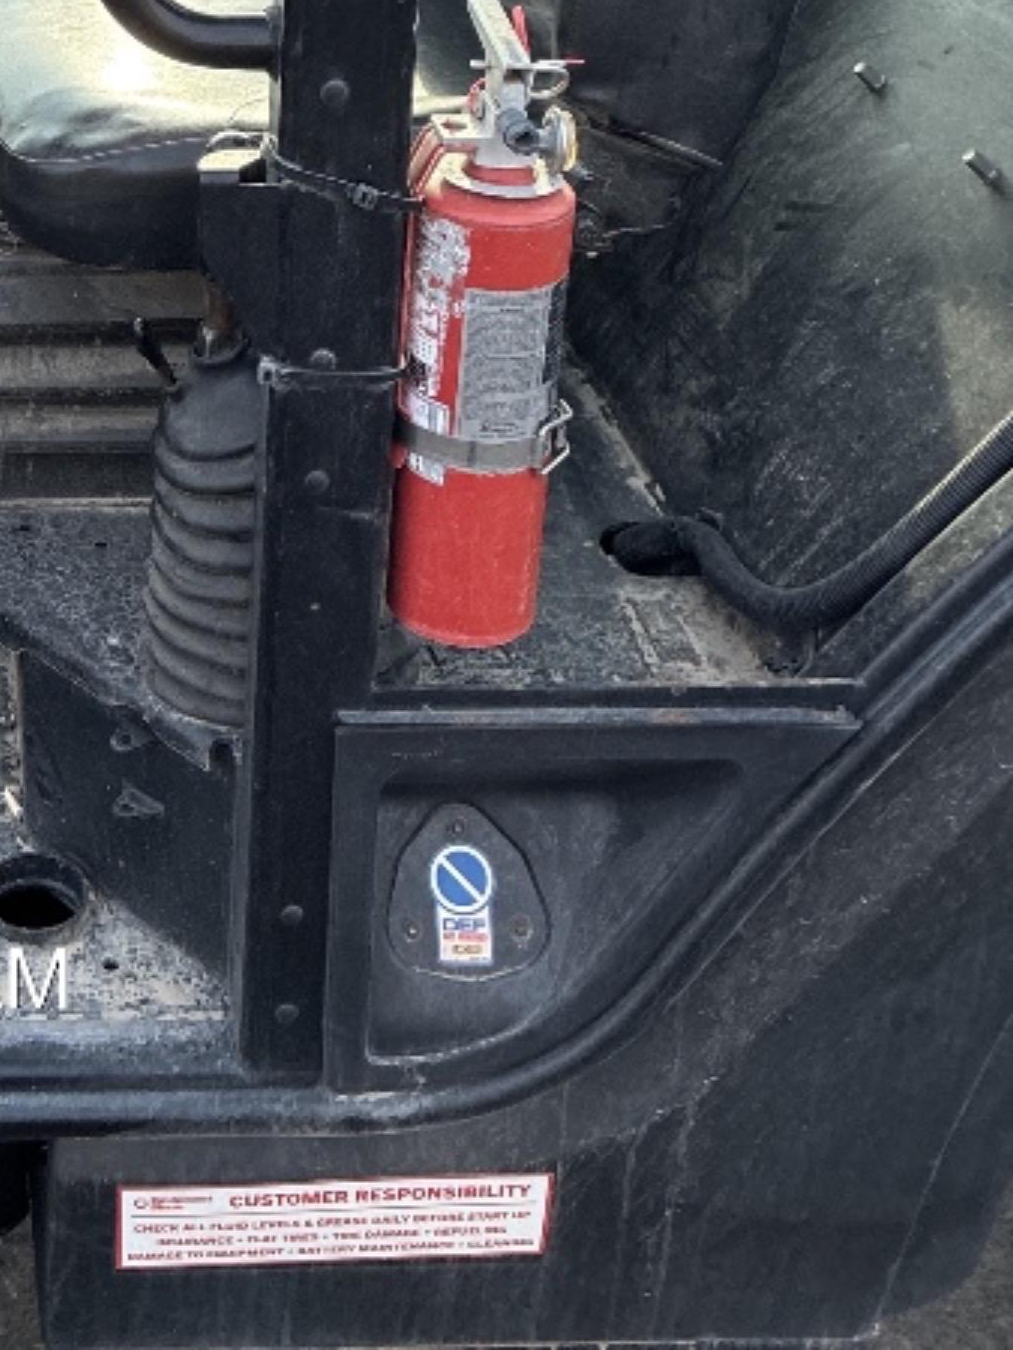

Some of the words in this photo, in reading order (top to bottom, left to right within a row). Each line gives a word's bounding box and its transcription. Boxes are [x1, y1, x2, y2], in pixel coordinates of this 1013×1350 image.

[443, 918, 486, 931] DEF
[228, 1191, 349, 1208] CUSTOMER
[355, 1184, 532, 1203] RESPONSIBILITY
[133, 1222, 180, 1234] CHECK
